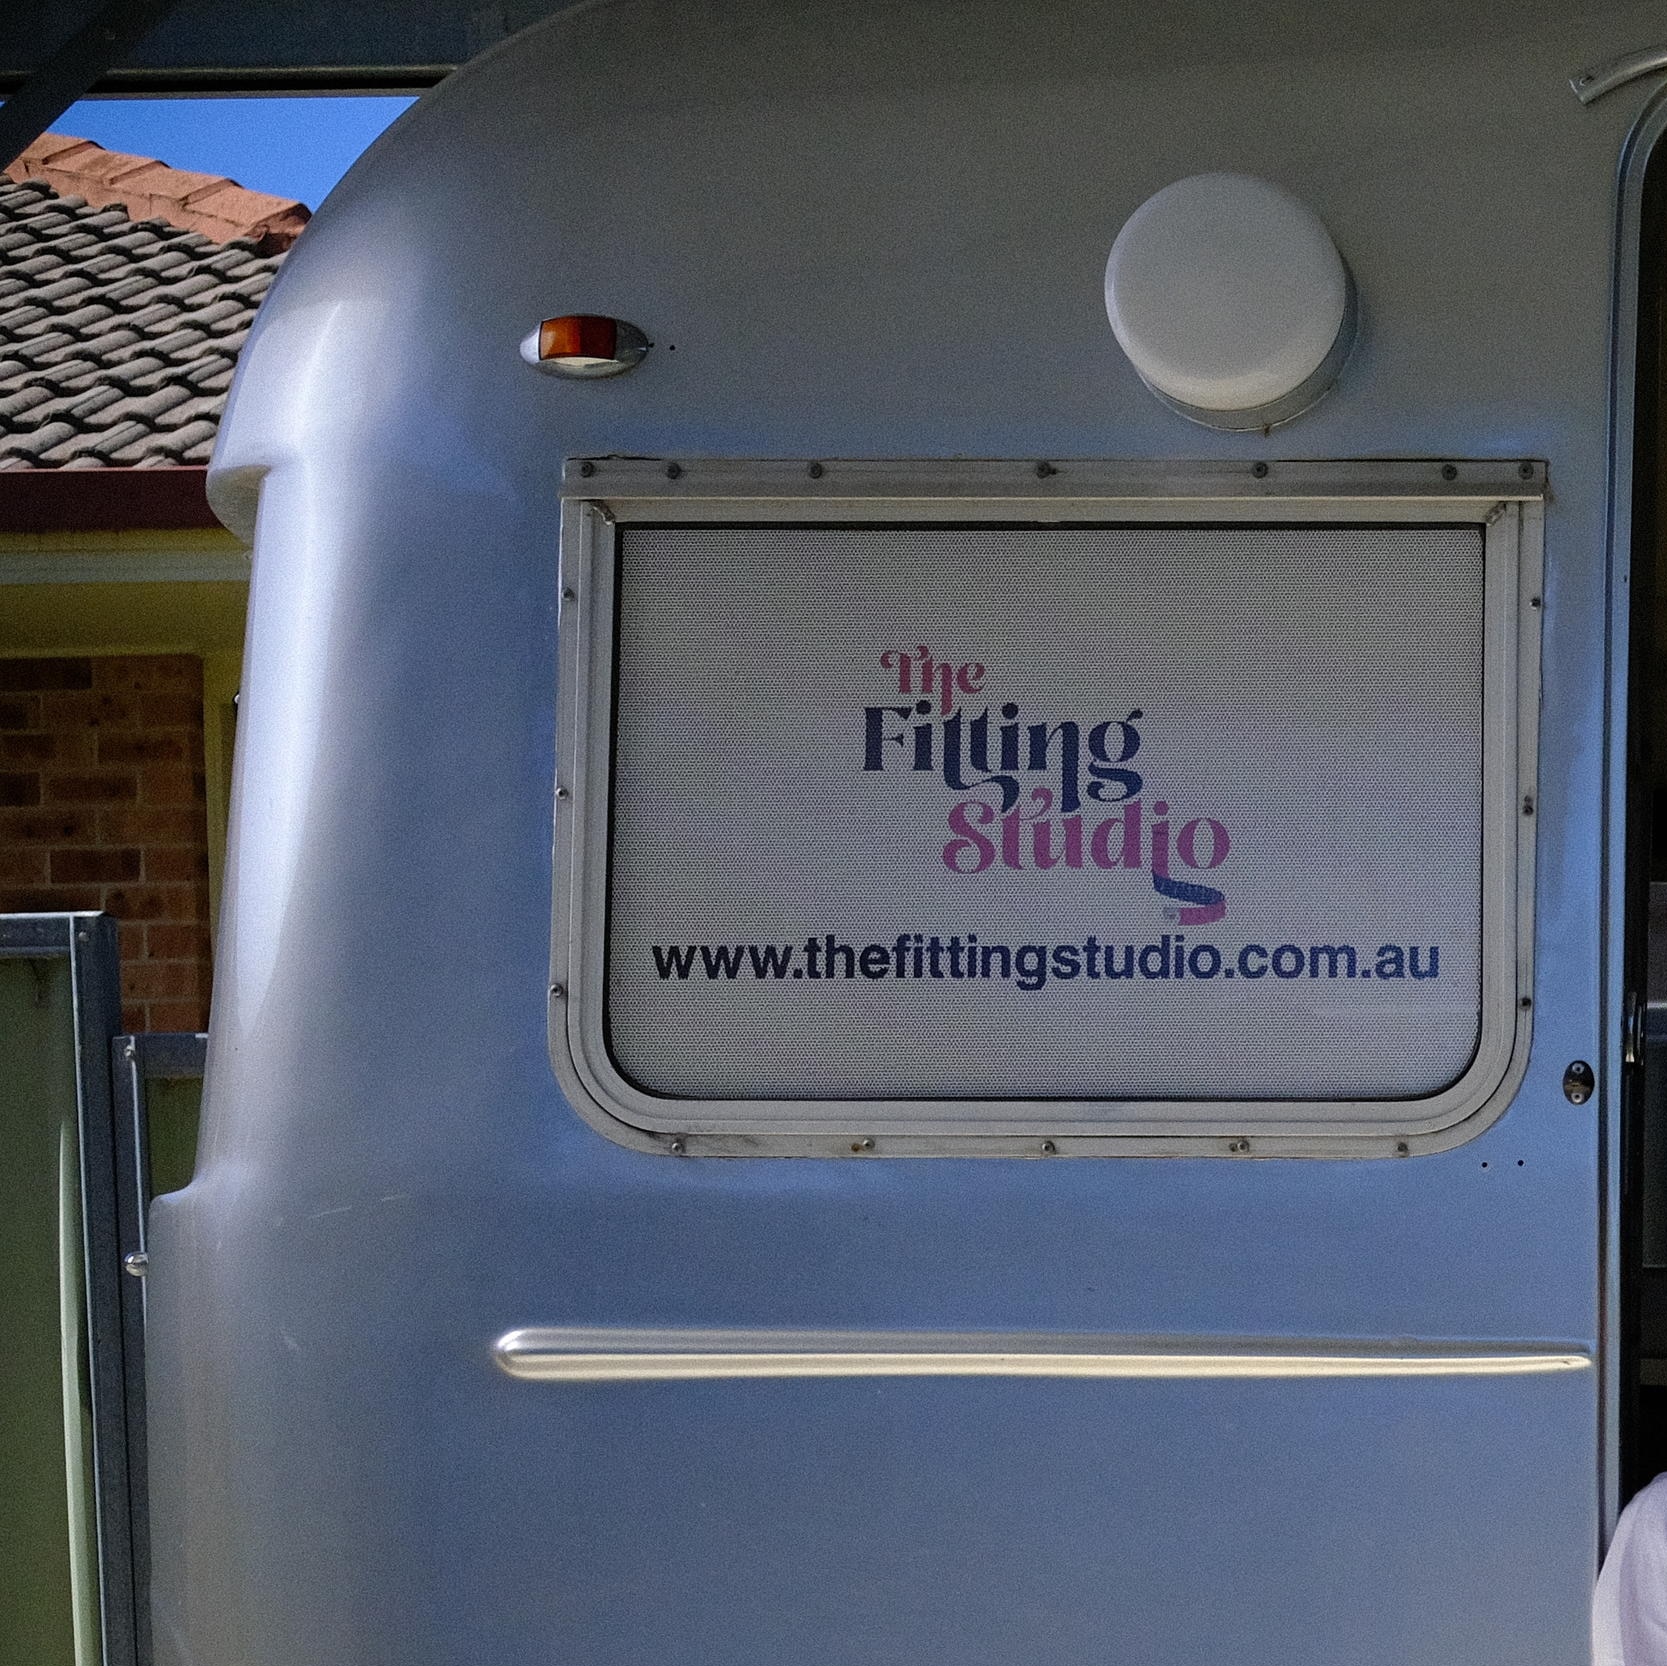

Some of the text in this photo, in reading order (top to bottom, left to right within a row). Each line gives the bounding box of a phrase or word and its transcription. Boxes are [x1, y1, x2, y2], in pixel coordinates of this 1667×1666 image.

[880, 645, 986, 715] The
[863, 700, 1144, 813] Fitting
[942, 787, 1231, 925] Studio
[651, 934, 1441, 990] www.thefittingstudio.com.au
